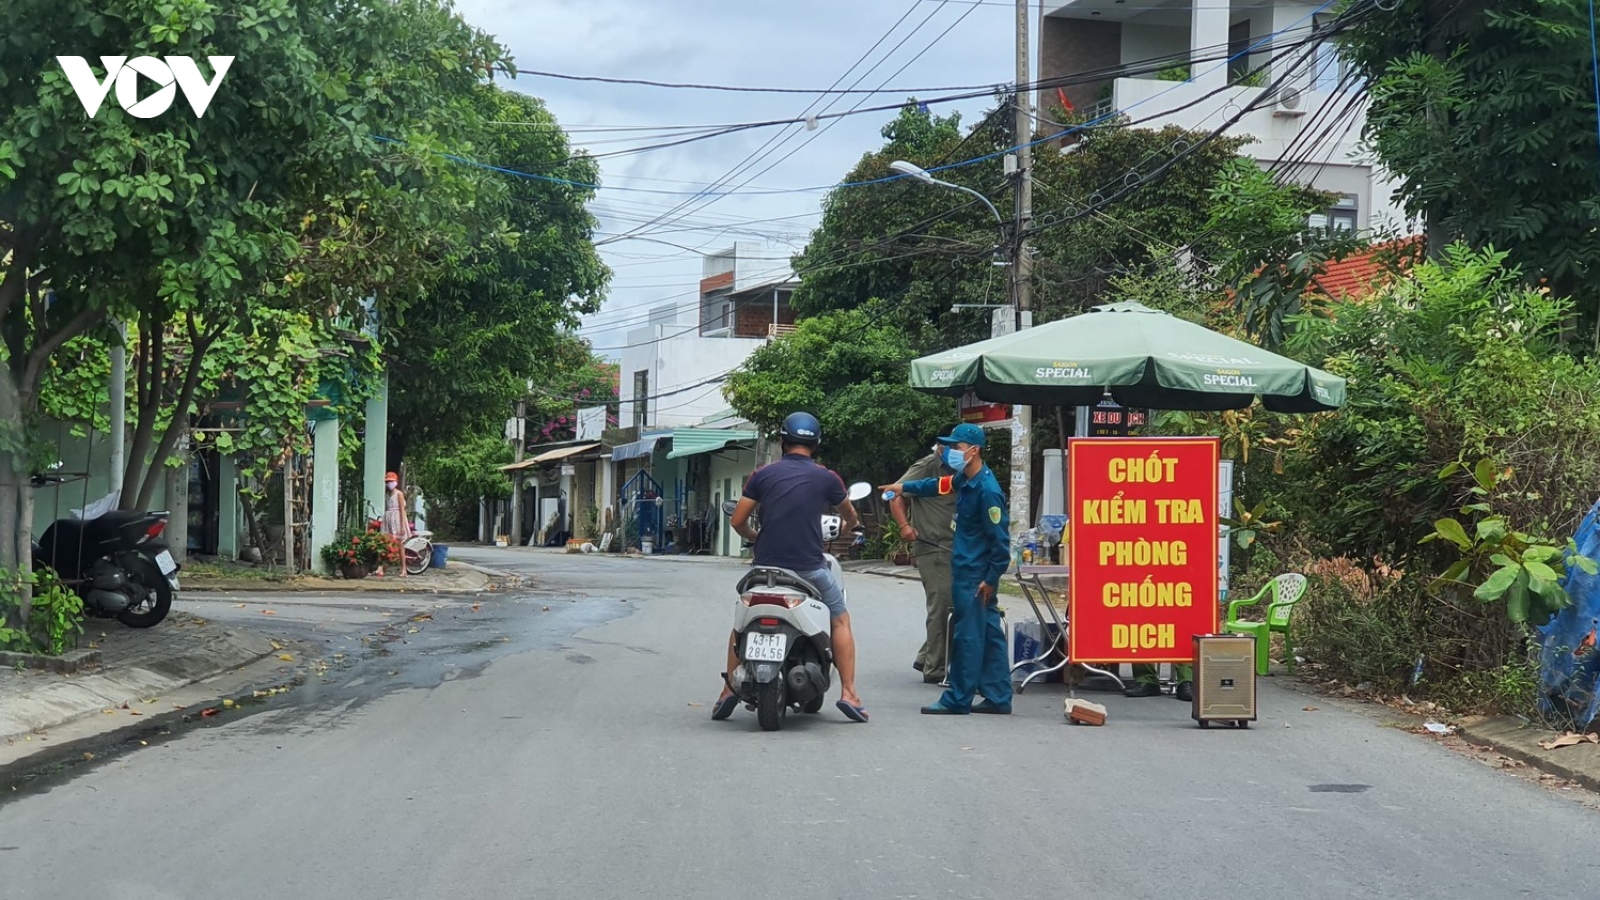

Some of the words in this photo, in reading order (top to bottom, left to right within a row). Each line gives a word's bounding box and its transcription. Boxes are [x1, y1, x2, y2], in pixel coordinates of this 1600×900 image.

[1035, 367, 1092, 378] SPECIAL
[1203, 373, 1258, 387] SPECIAL
[1093, 411, 1106, 424] XE
[1107, 412, 1122, 425] DU
[1127, 413, 1145, 427] ỊCH
[1108, 449, 1179, 483] CHỐT
[1083, 490, 1147, 524] KIỂM
[1154, 499, 1205, 524] TRA
[1099, 537, 1188, 566] PHÒNG
[1102, 574, 1193, 608] CHỐNG
[1111, 623, 1176, 653] DỊCH
[748, 647, 783, 659] 284.56
